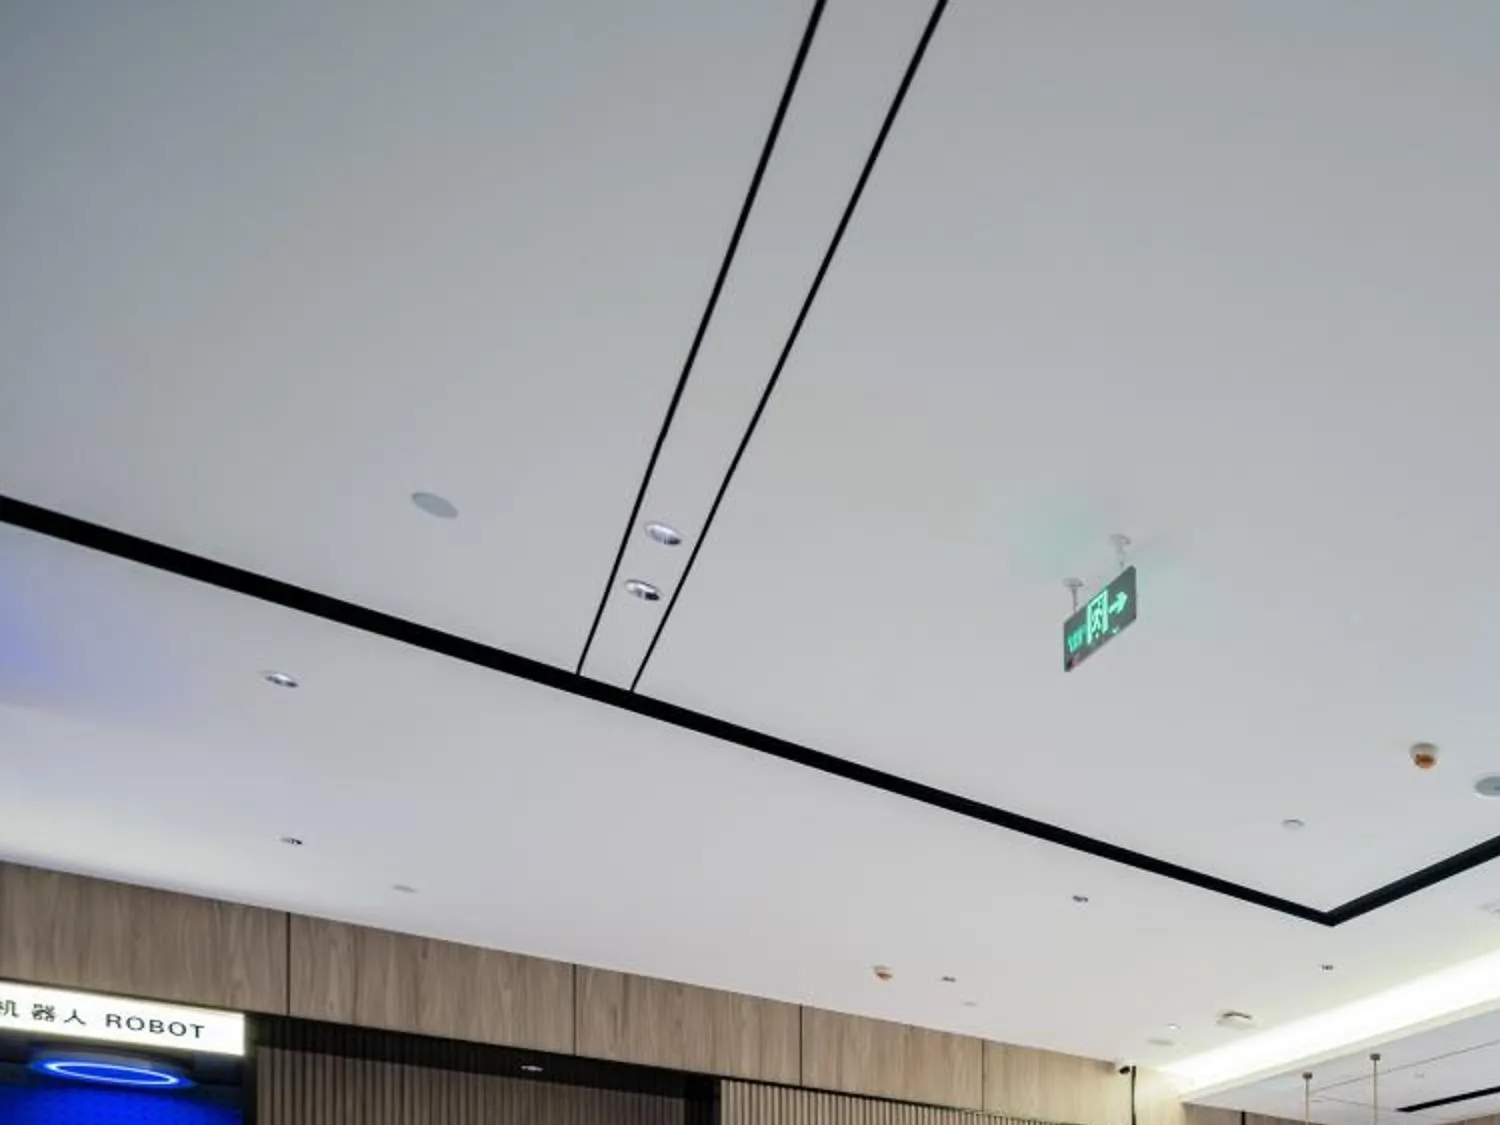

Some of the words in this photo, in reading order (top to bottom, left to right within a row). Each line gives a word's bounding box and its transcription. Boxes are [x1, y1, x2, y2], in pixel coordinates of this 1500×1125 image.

[0, 1000, 86, 1025] 机器人
[105, 1013, 205, 1038] ROBOT
